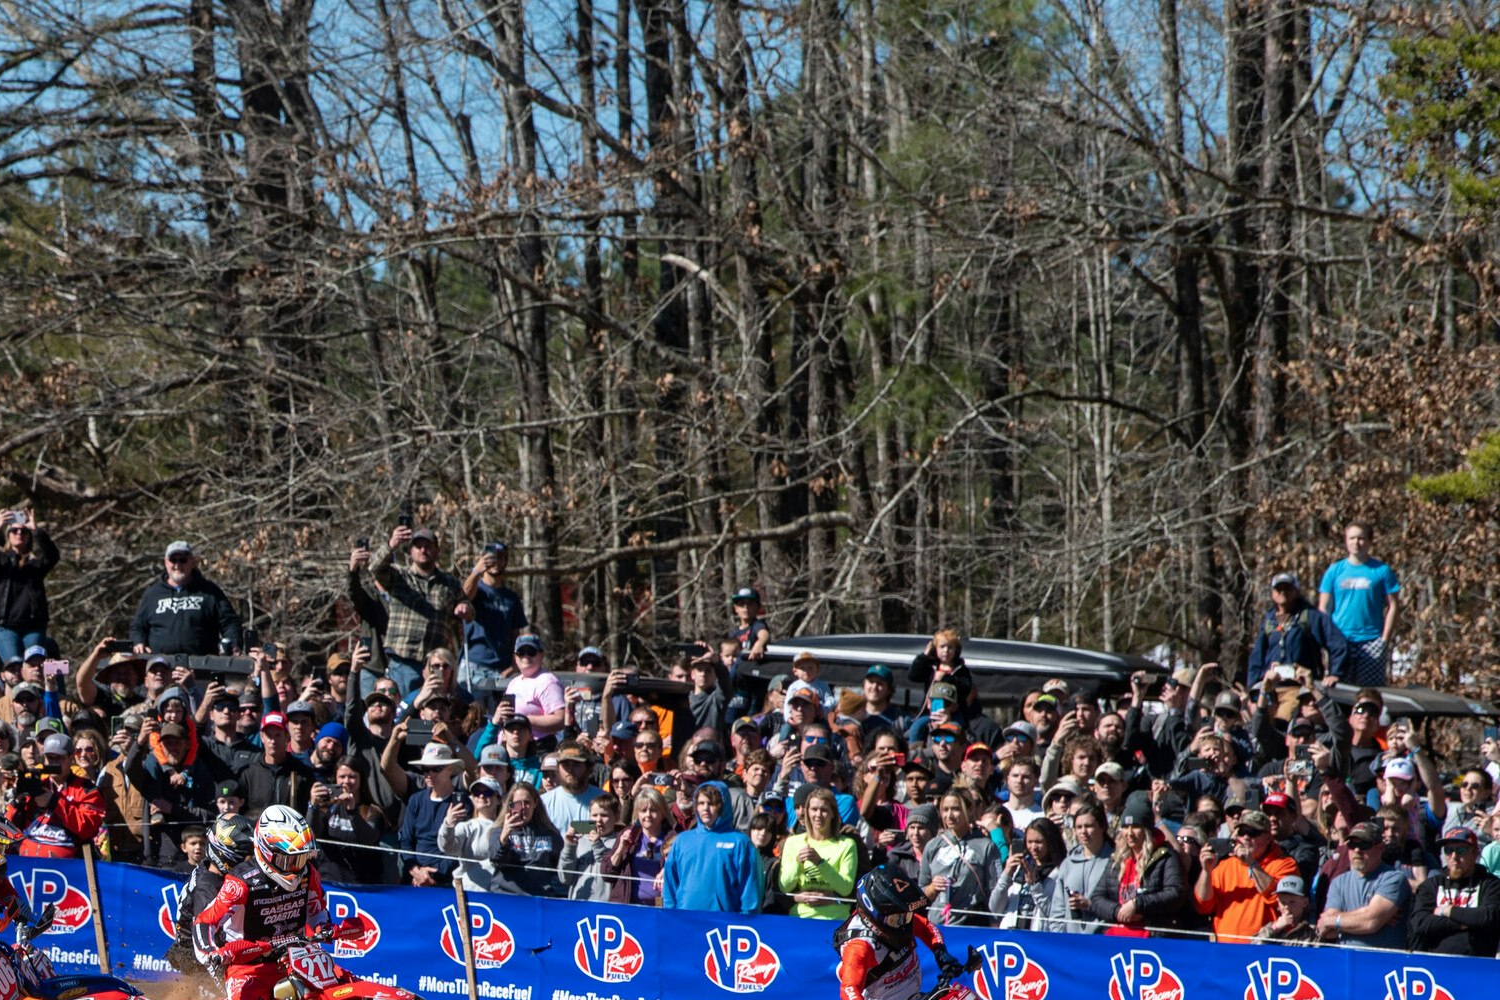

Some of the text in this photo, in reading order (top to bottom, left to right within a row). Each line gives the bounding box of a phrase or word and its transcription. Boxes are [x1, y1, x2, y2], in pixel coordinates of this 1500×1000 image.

[260, 899, 305, 916] GASGAS
[263, 908, 302, 926] COASTAL
[51, 924, 75, 933] UELS
[442, 902, 494, 967] VP
[338, 949, 364, 957] FUELS
[475, 940, 512, 958] Racing
[577, 915, 624, 980] VP
[608, 953, 642, 972] Racing
[706, 925, 760, 990] VP
[301, 954, 335, 982] 212
[738, 963, 778, 982] Racing
[418, 976, 532, 1000] #MoreThnRaceFuel
[1009, 980, 1047, 998] Racing
